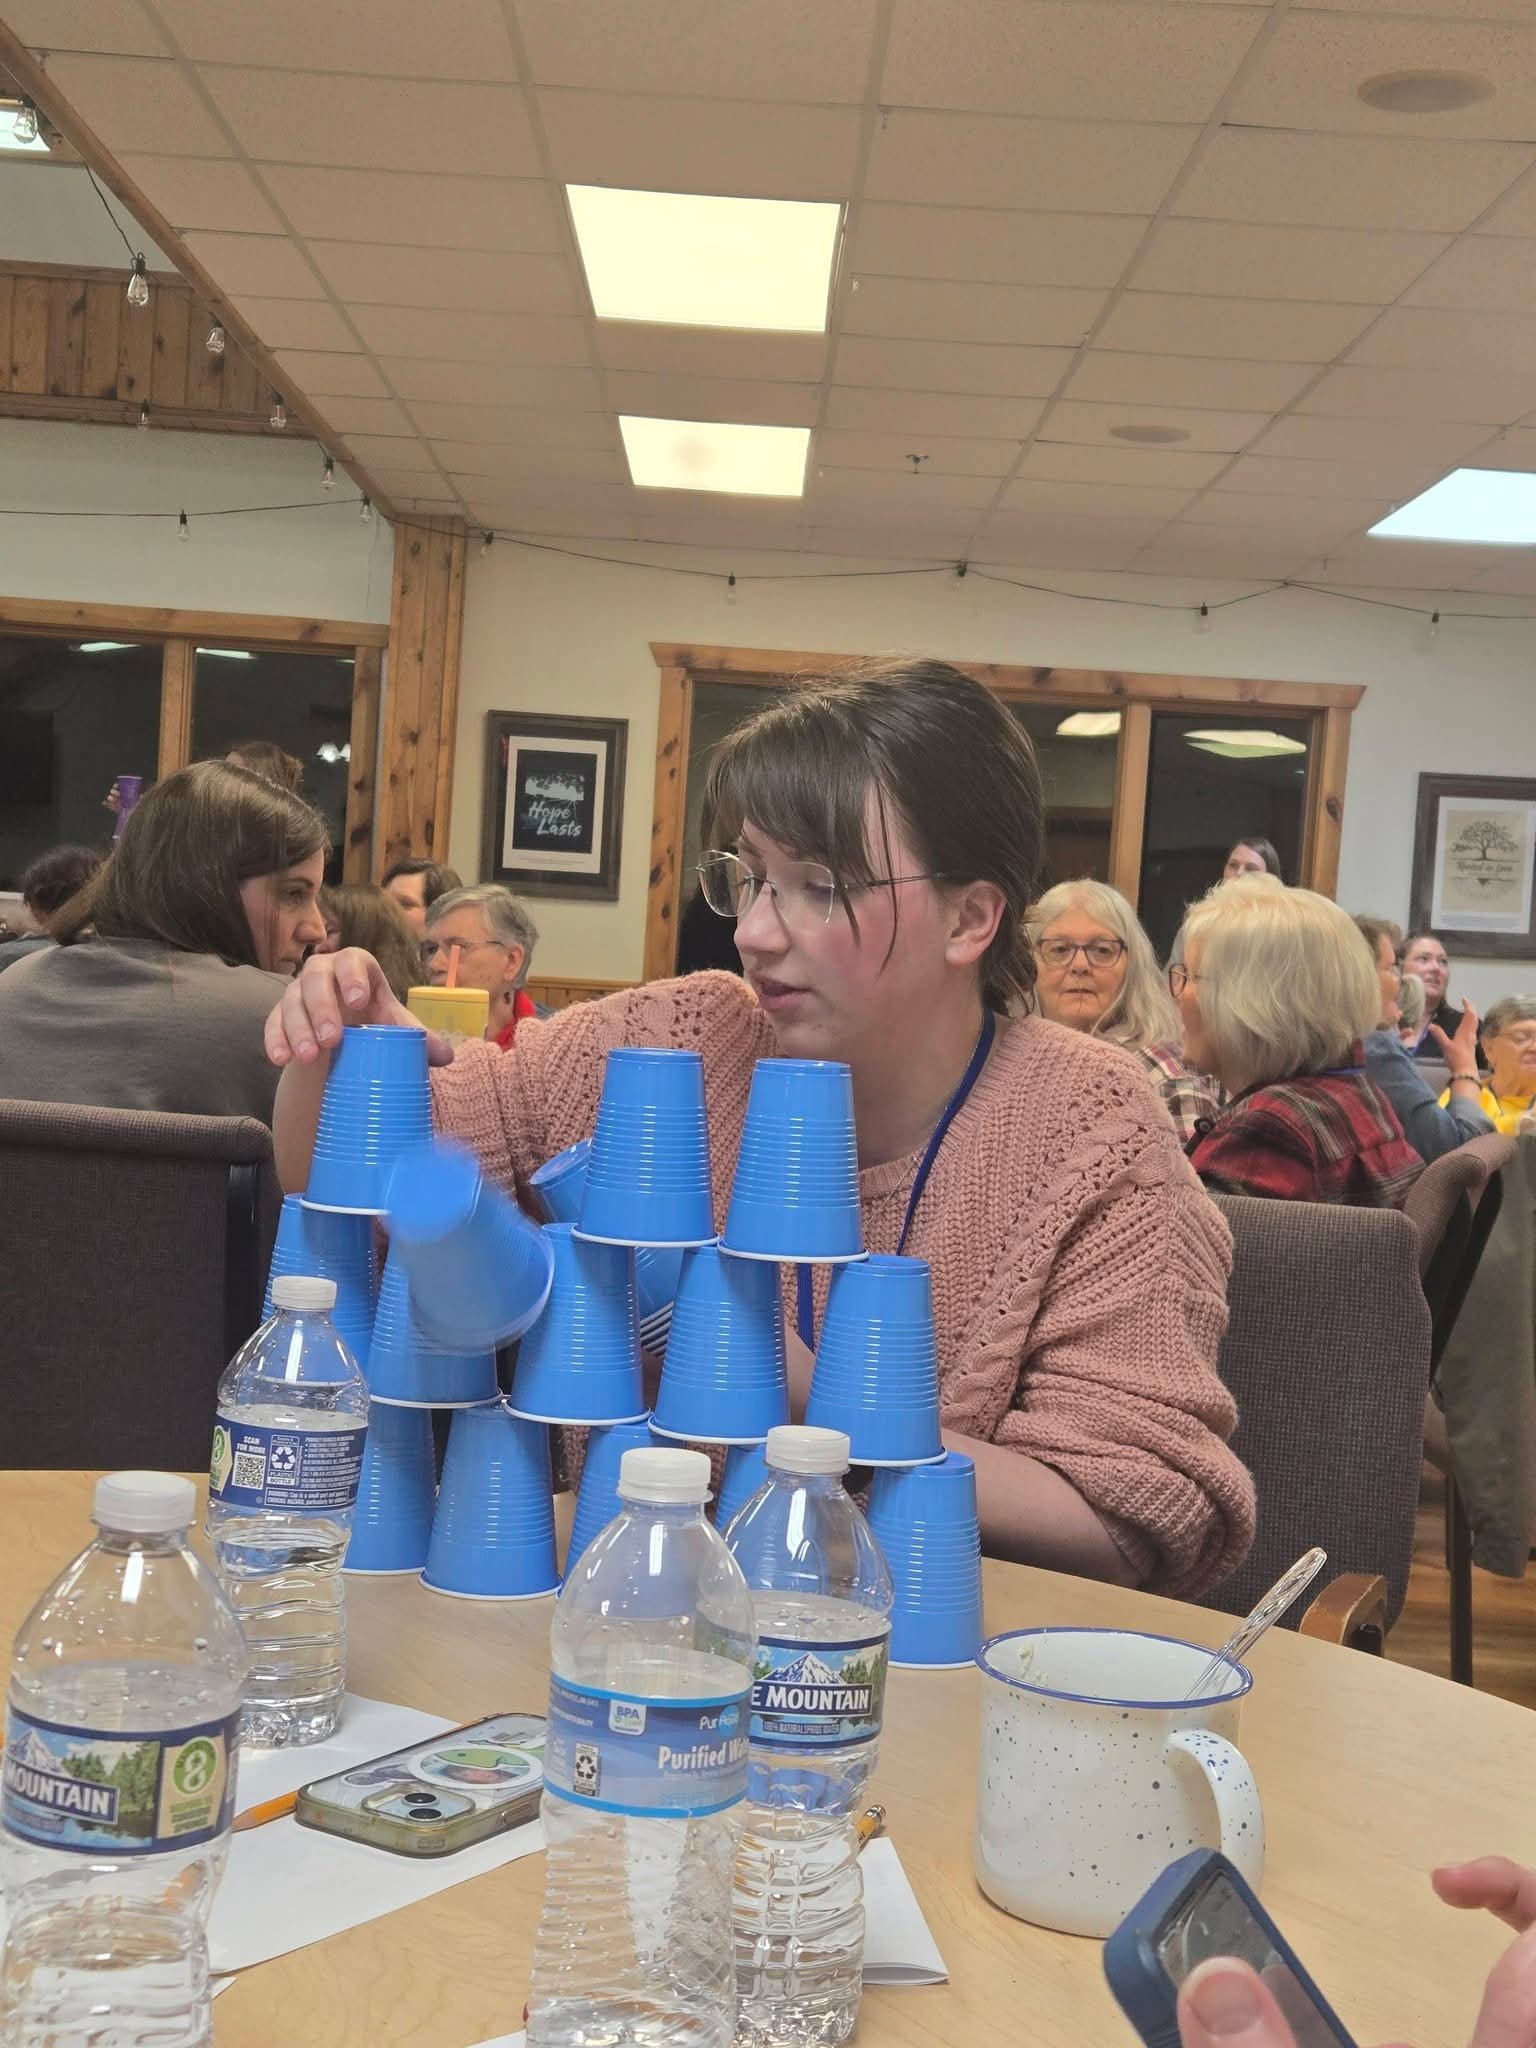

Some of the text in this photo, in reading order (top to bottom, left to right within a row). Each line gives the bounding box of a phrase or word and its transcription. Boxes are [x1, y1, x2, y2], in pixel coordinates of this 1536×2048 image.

[529, 801, 570, 823] Hope
[536, 817, 583, 837] Lasts
[236, 1443, 248, 1452] FOR
[243, 1436, 260, 1445] SCAN
[271, 1477, 294, 1485] BOTTLE
[765, 1685, 869, 1710] MOUNTAIN
[616, 1705, 641, 1721] BPA
[658, 1742, 725, 1769] Purified
[4, 1764, 109, 1816] MOUNTAIN
